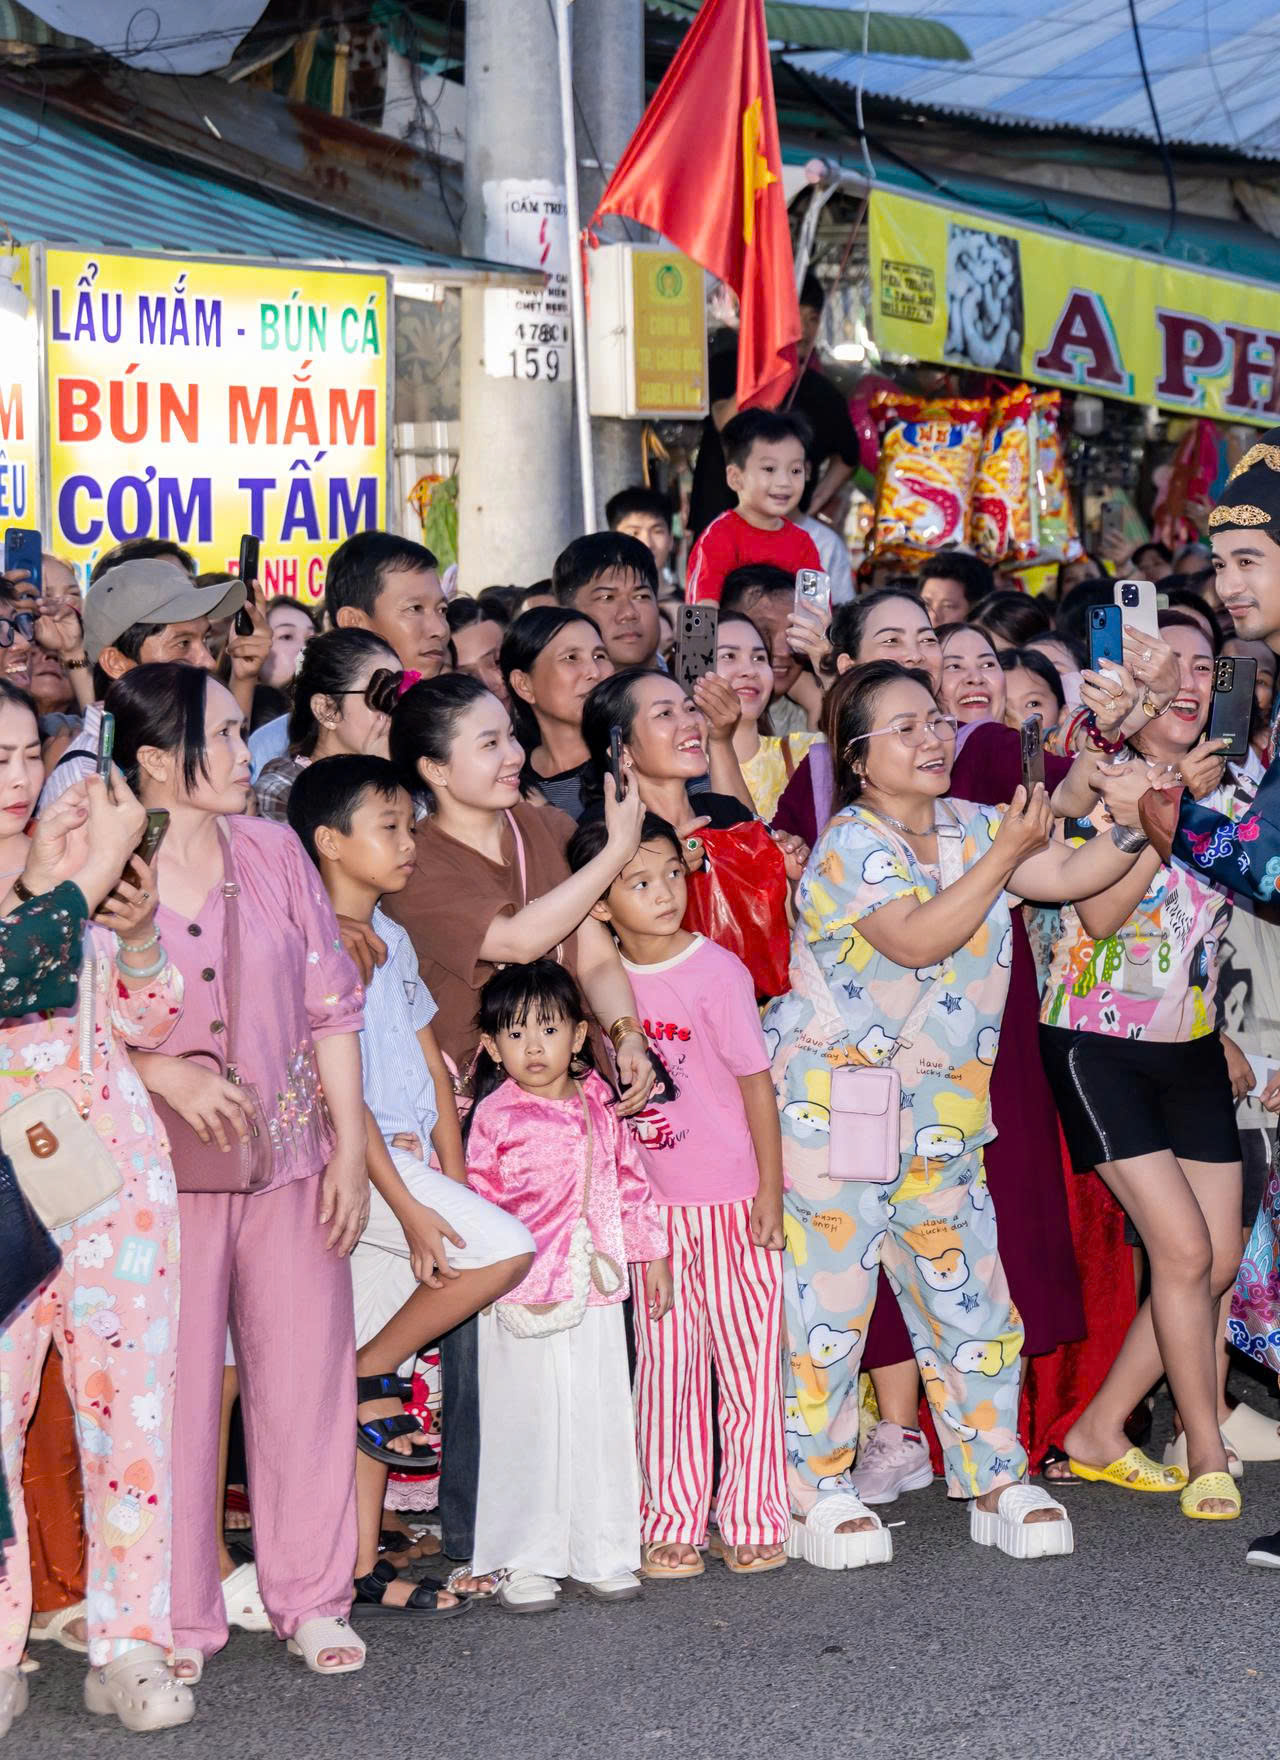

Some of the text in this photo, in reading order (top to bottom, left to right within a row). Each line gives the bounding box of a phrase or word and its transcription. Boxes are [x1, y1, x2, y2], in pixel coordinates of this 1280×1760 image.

[51, 262, 122, 343] LẨU
[138, 273, 222, 348] MẮM
[260, 291, 327, 353] BÚN
[340, 295, 380, 355] CÁ
[1035, 291, 1125, 388] A
[58, 360, 376, 445] BÚN MẮM
[510, 347, 560, 382] 159
[58, 451, 378, 546] CƠM TẤM
[919, 1057, 943, 1069] Have
[944, 1072, 962, 1081] day
